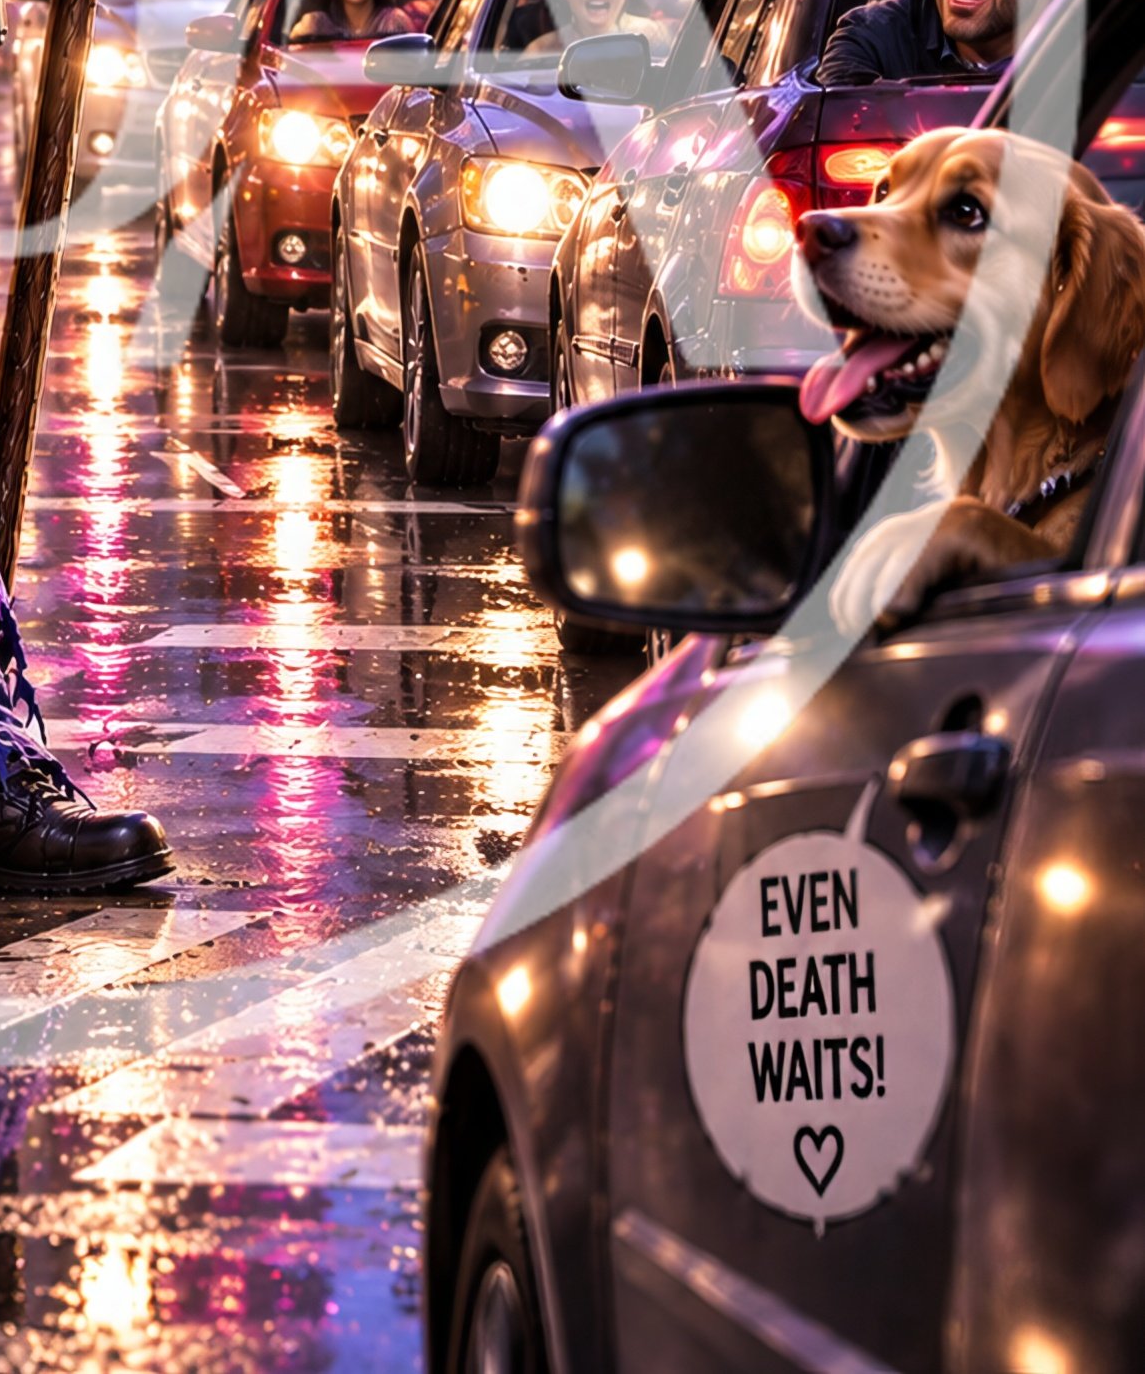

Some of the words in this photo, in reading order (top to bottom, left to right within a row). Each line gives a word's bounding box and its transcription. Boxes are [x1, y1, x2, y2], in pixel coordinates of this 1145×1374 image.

[760, 868, 859, 937] EVEN
[749, 951, 876, 1020] DEATH
[748, 1035, 886, 1103] WAITS!
